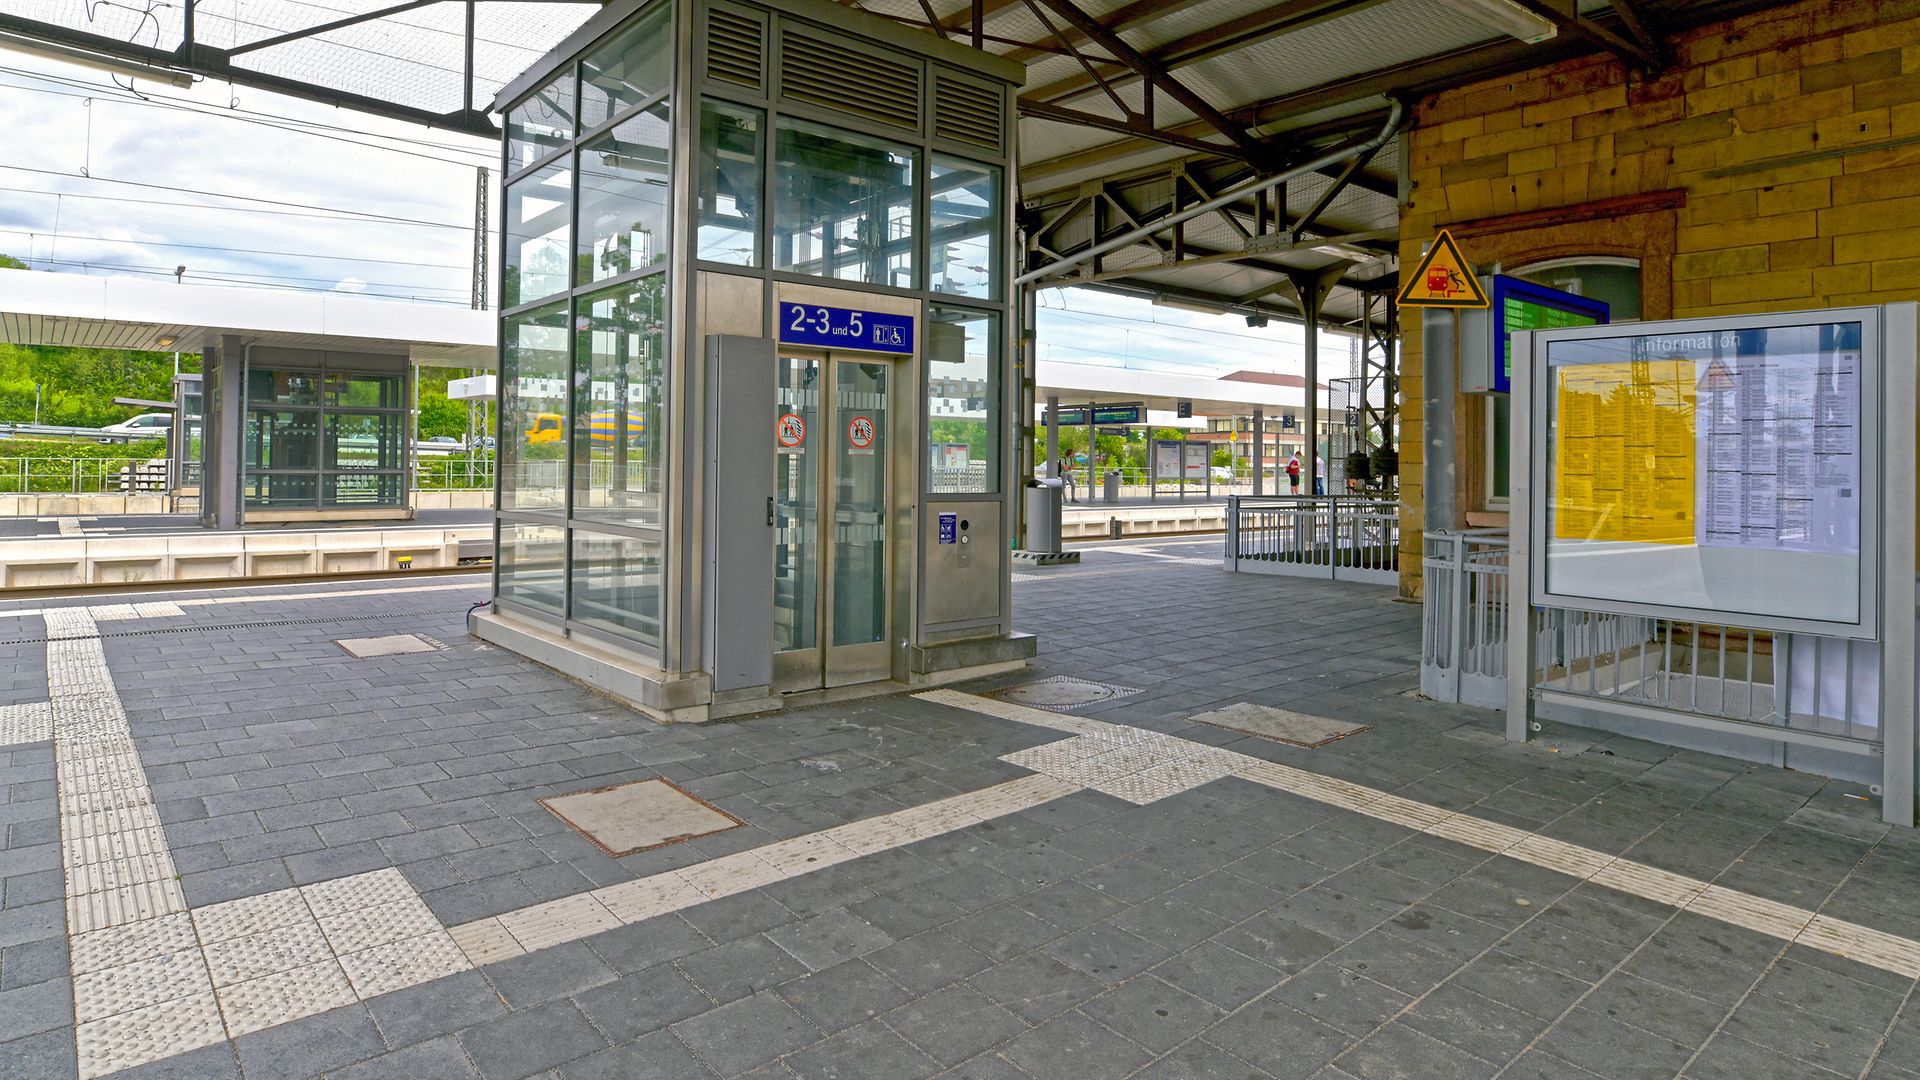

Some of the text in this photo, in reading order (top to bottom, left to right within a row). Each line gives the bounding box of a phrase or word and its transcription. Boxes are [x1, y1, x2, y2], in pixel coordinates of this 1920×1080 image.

[790, 305, 863, 337] 2-3 und 5
[1286, 415, 1293, 426] 3
